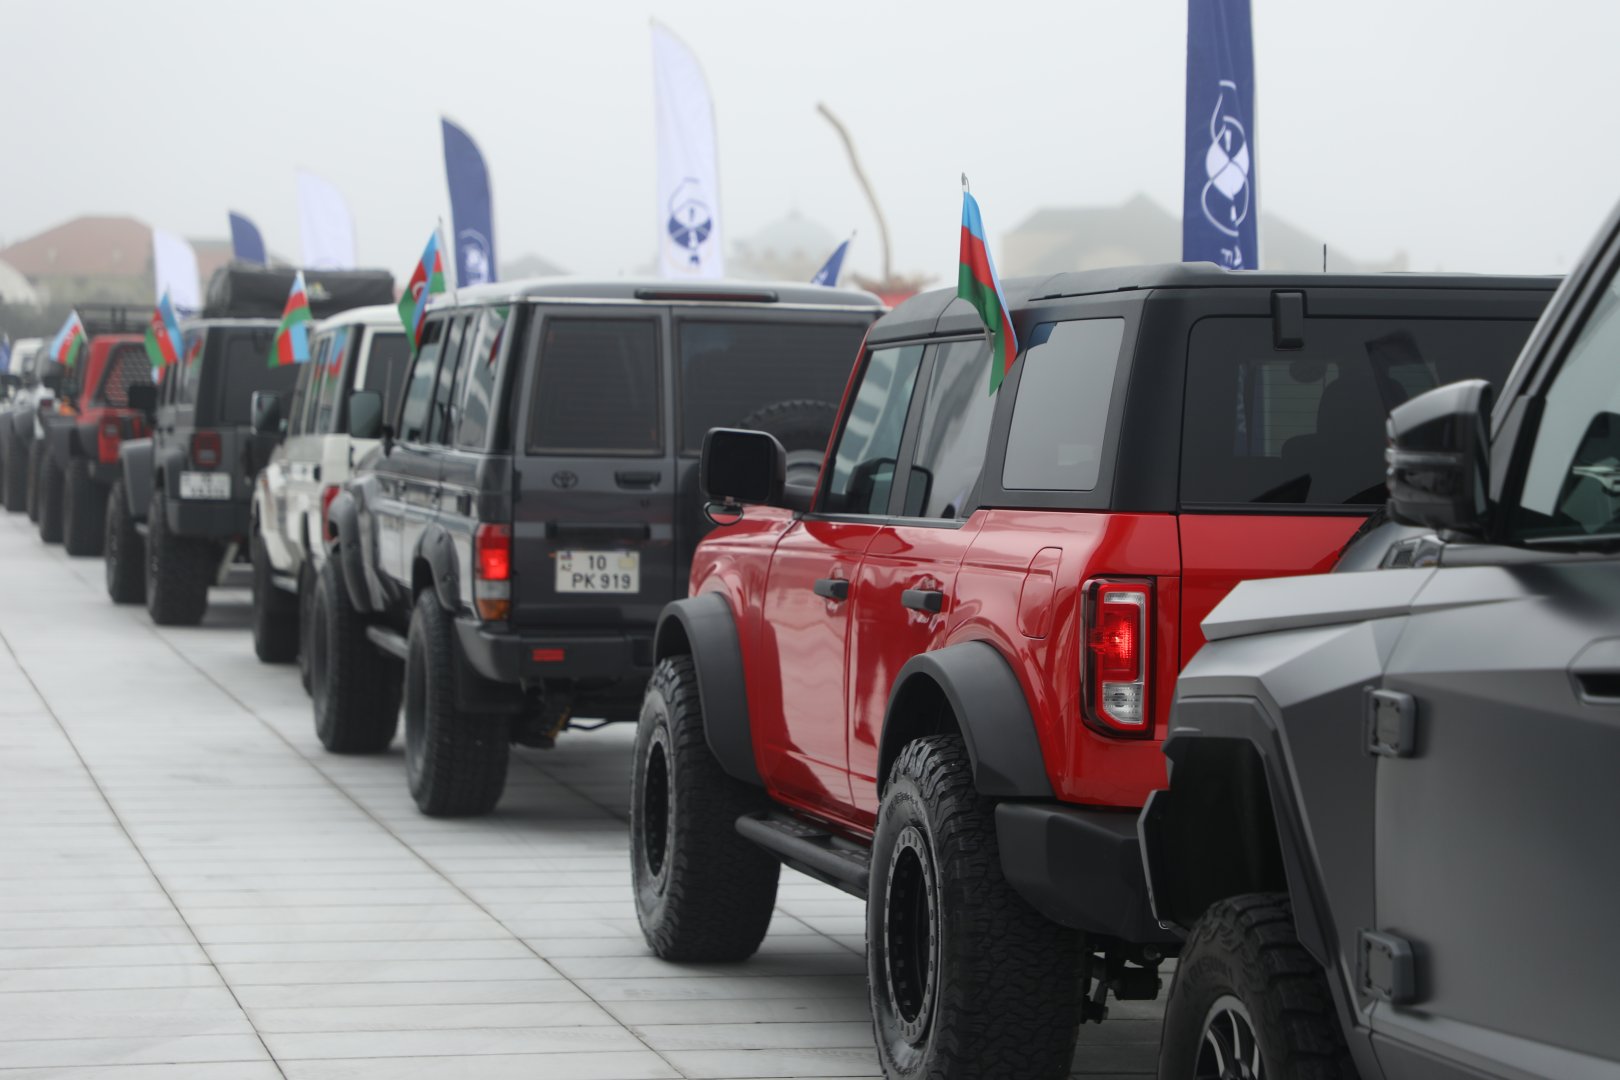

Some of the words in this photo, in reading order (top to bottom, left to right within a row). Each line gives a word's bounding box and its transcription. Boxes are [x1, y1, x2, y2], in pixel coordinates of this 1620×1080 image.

[589, 555, 607, 571] 10
[572, 572, 595, 589] PK
[600, 573, 631, 589] 919
